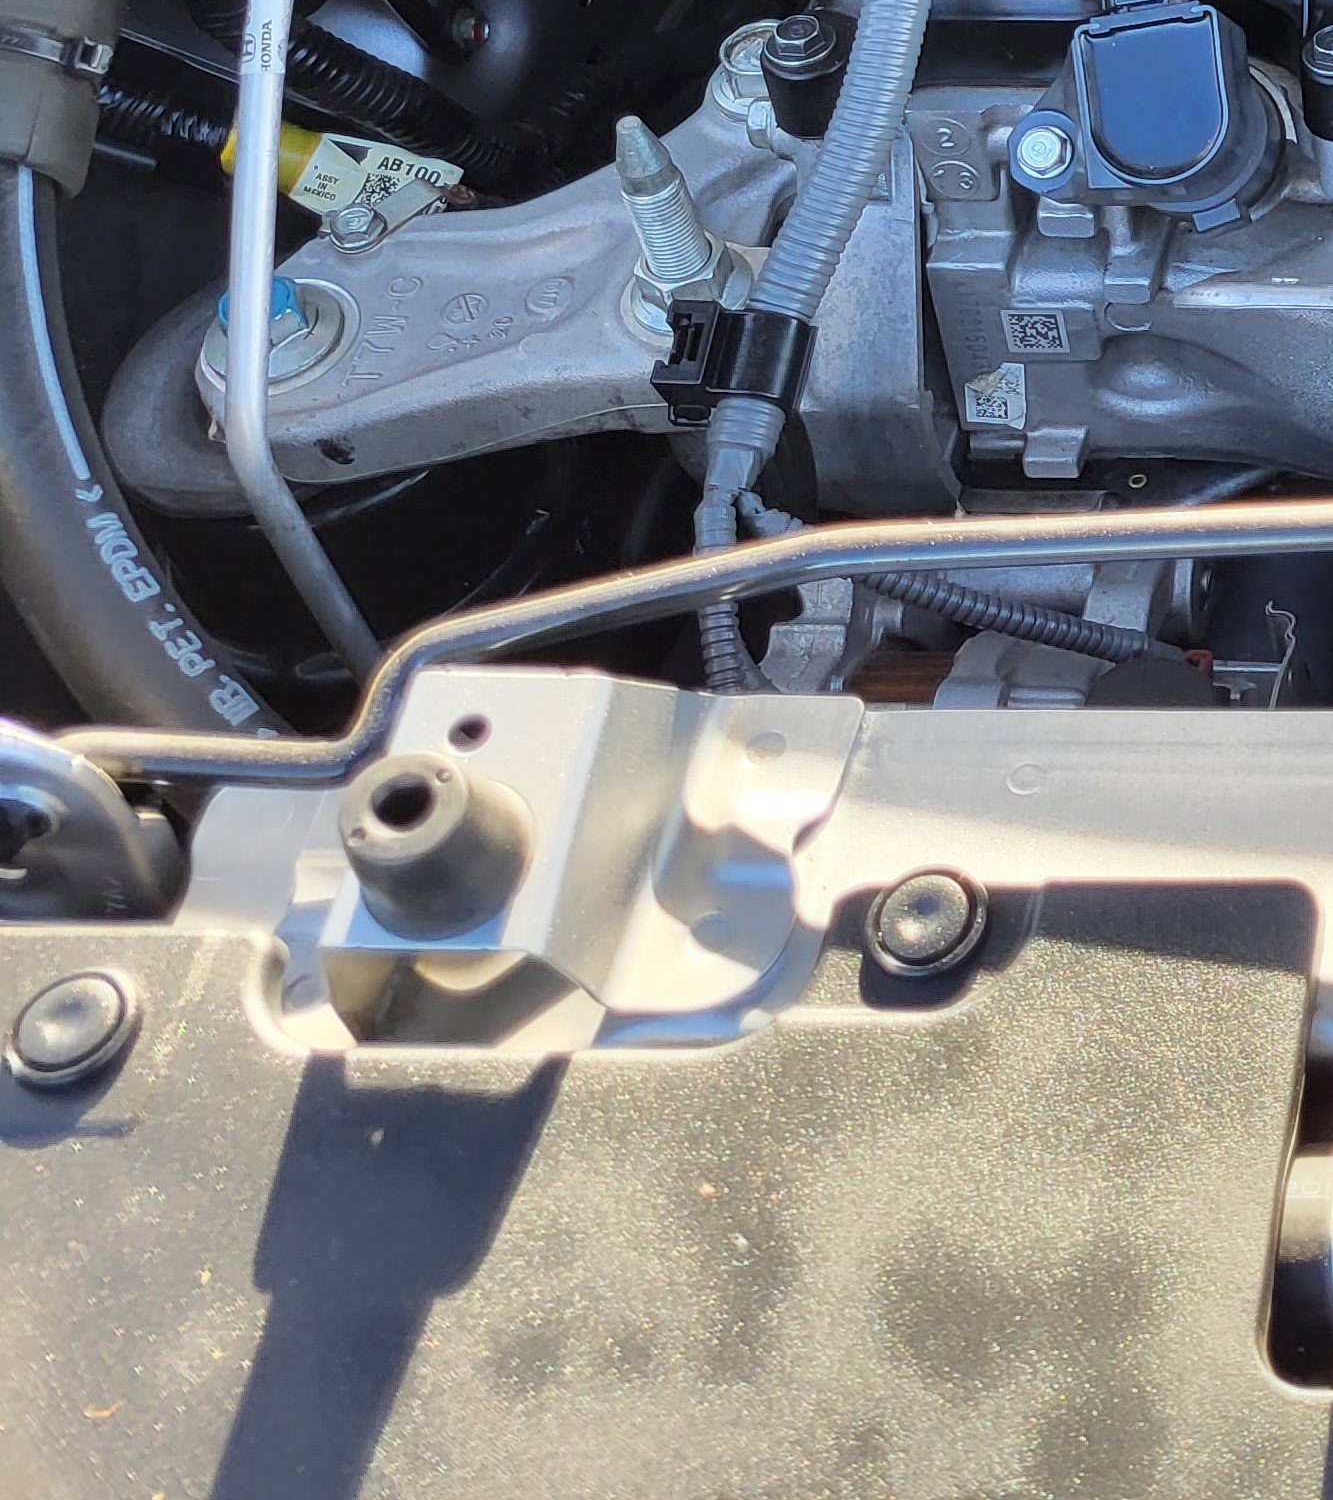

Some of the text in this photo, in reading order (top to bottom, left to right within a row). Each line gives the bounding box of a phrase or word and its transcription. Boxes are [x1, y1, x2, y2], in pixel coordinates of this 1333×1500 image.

[315, 172, 341, 185] ASSY
[303, 185, 337, 201] MEXICO
[317, 182, 328, 191] IN
